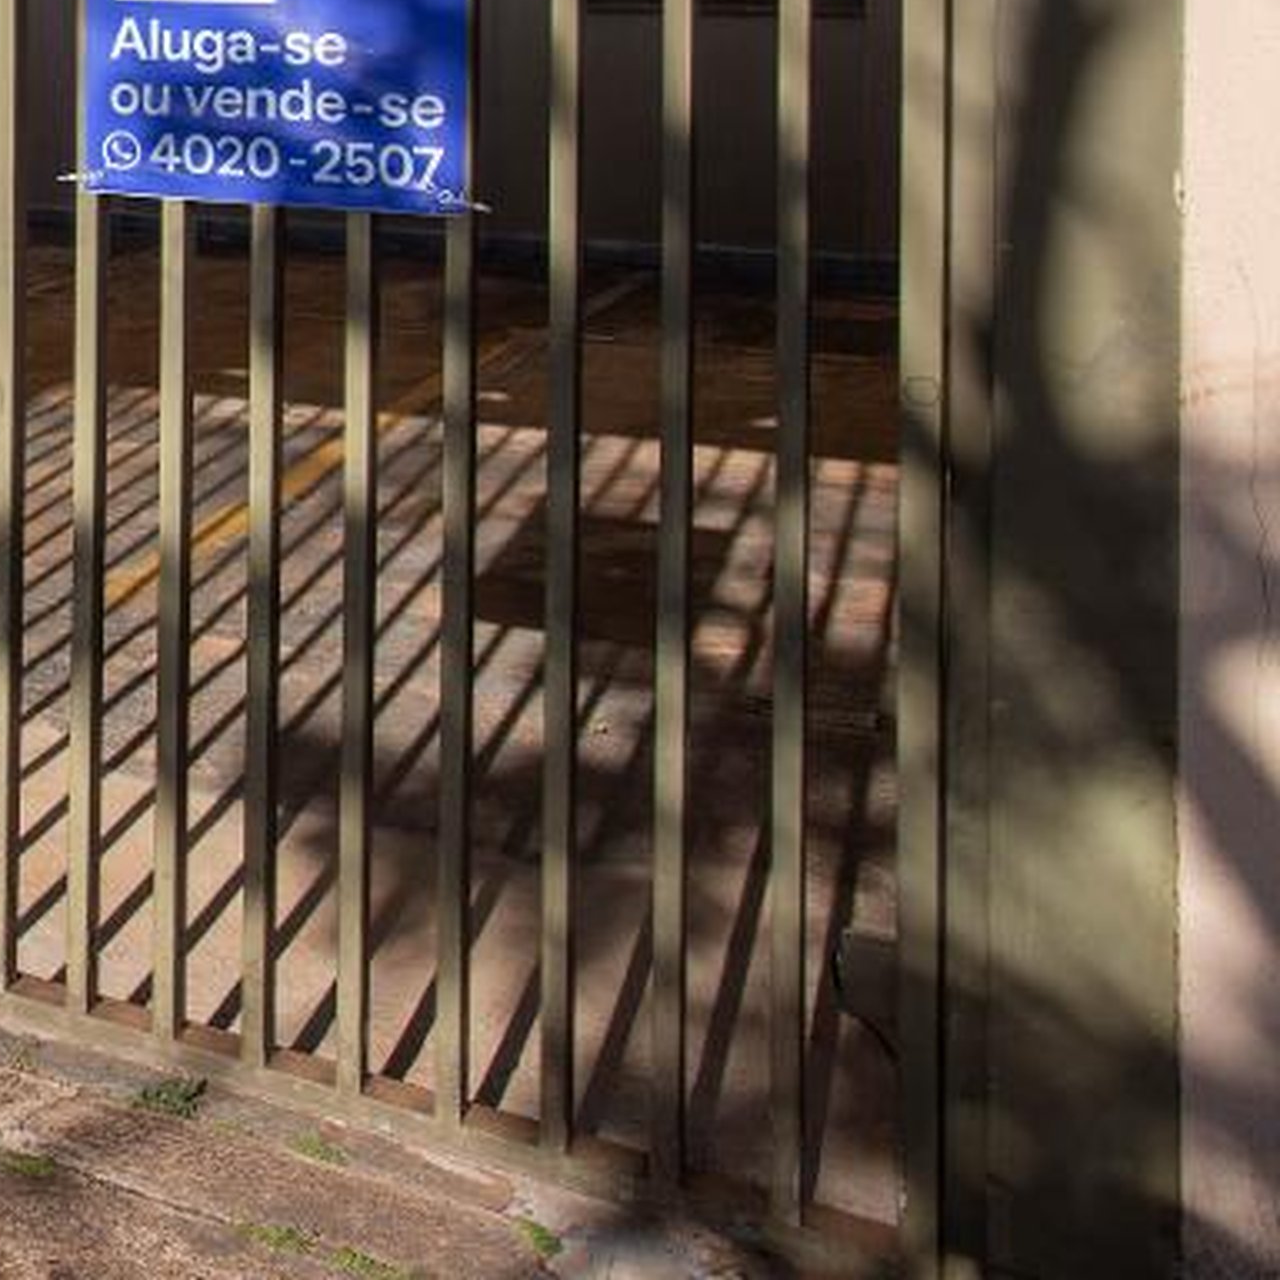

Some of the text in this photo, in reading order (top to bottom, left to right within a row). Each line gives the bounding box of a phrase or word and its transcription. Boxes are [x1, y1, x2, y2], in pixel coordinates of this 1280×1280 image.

[110, 18, 348, 74] Aluga-se
[110, 79, 447, 129] ou vende-se
[149, 132, 445, 191] 4020-2507
